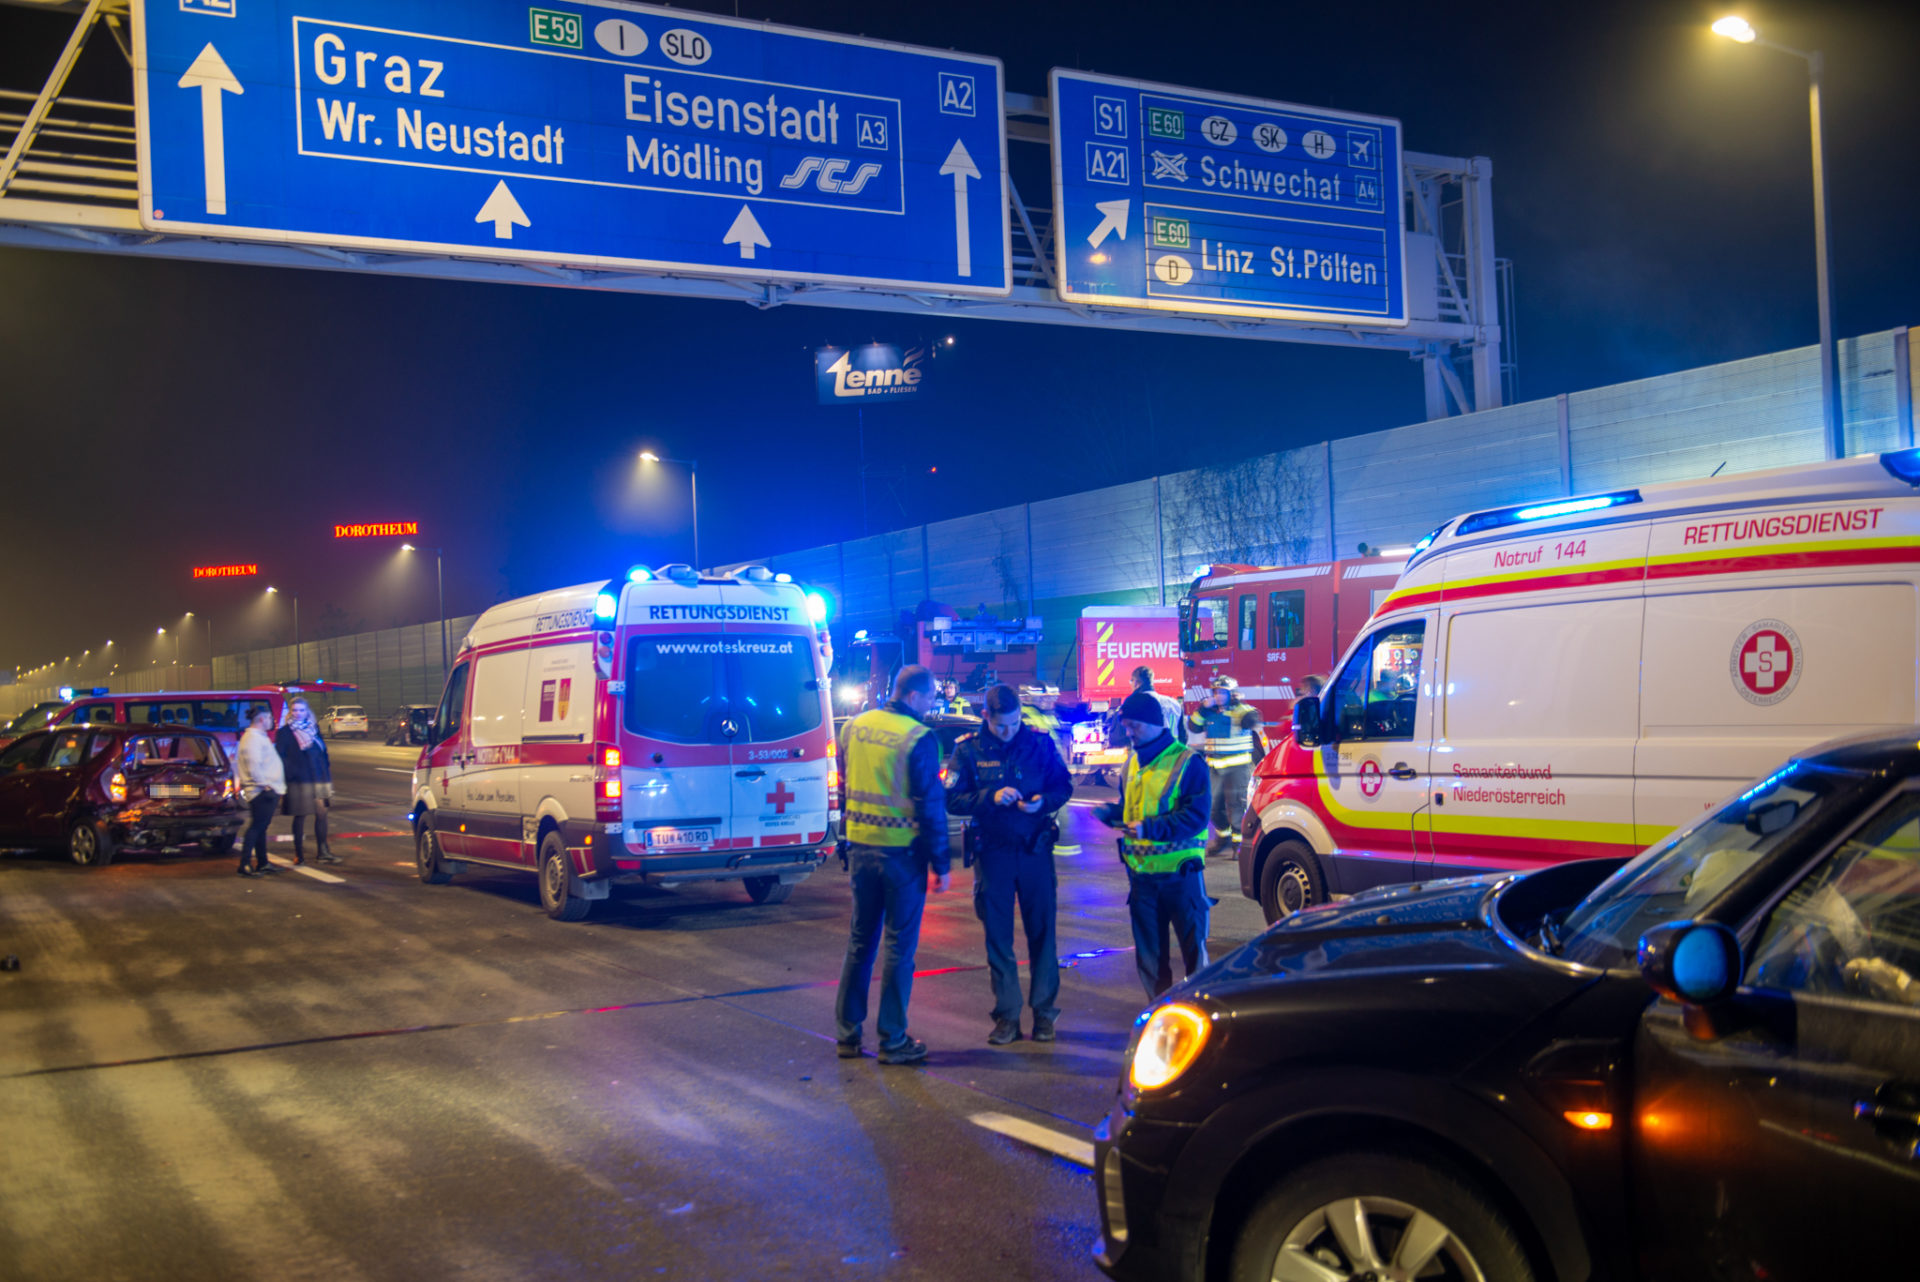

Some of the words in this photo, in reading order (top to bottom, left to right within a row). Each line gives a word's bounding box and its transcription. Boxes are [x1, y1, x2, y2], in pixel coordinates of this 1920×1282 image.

[533, 14, 579, 43] E59
[666, 33, 706, 60] SLO
[313, 33, 445, 98] Graz
[944, 80, 972, 110] A2
[624, 73, 839, 145] Eisenstadt
[861, 119, 886, 145] A3
[1099, 103, 1123, 131] S1
[316, 98, 382, 146] Wr.
[397, 107, 565, 164] Neustadt
[1152, 112, 1182, 135] E60
[1209, 120, 1229, 142] CZ
[1259, 127, 1279, 149] SK
[1314, 135, 1324, 155] H
[627, 135, 763, 195] Mödling
[1091, 150, 1126, 179] A21
[1201, 155, 1340, 202] Schwechat
[1358, 181, 1376, 199] A4
[1157, 222, 1186, 243] E60
[1201, 239, 1255, 275] Linz
[1168, 260, 1179, 281] D
[825, 350, 922, 397] tenne
[867, 387, 882, 395] BAD
[889, 386, 917, 394] FLIESEN
[334, 522, 418, 538] DOROTHEUM
[1683, 508, 1884, 546] RETTUNGSDIENST
[1494, 546, 1544, 568] Notruf
[1554, 540, 1587, 561] 144
[193, 563, 258, 579] DOROTHEUM
[649, 605, 790, 622] RETTUNGSDIENST
[656, 639, 794, 655] www.roteskreuz.at
[1758, 650, 1773, 673] S
[1452, 763, 1553, 780] Samariterbund
[1452, 787, 1566, 806] Niederösterreich
